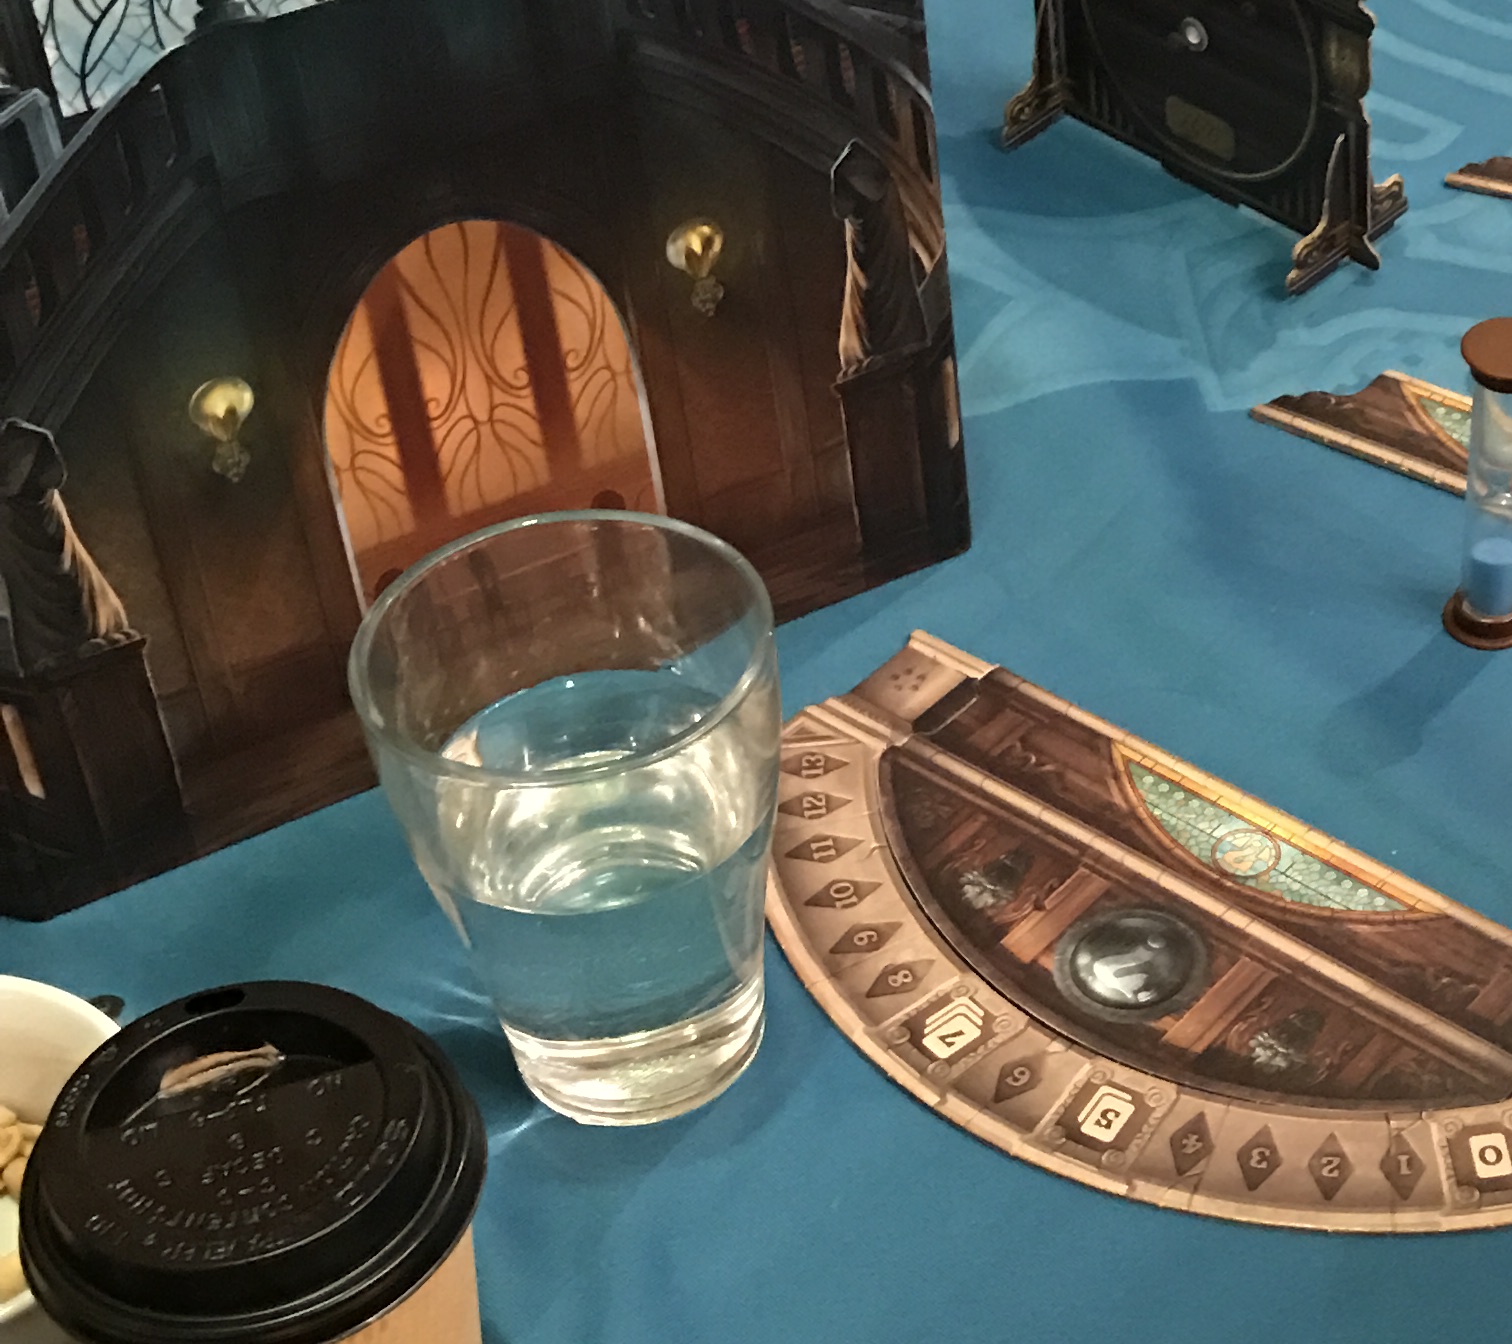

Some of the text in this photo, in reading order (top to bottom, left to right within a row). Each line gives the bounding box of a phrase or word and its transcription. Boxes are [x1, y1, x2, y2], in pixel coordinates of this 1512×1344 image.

[801, 754, 826, 778] 13
[802, 793, 827, 820] 12
[810, 837, 837, 861] 11
[829, 881, 858, 909] 10
[853, 929, 878, 947] 9
[887, 969, 913, 988] 8
[938, 1029, 965, 1048] 7
[1005, 1066, 1031, 1087] 6
[1093, 1107, 1121, 1130] 5
[1181, 1133, 1203, 1155] 4
[1249, 1146, 1272, 1169] 3
[1320, 1156, 1342, 1178] 2
[1399, 1154, 1413, 1175] 1
